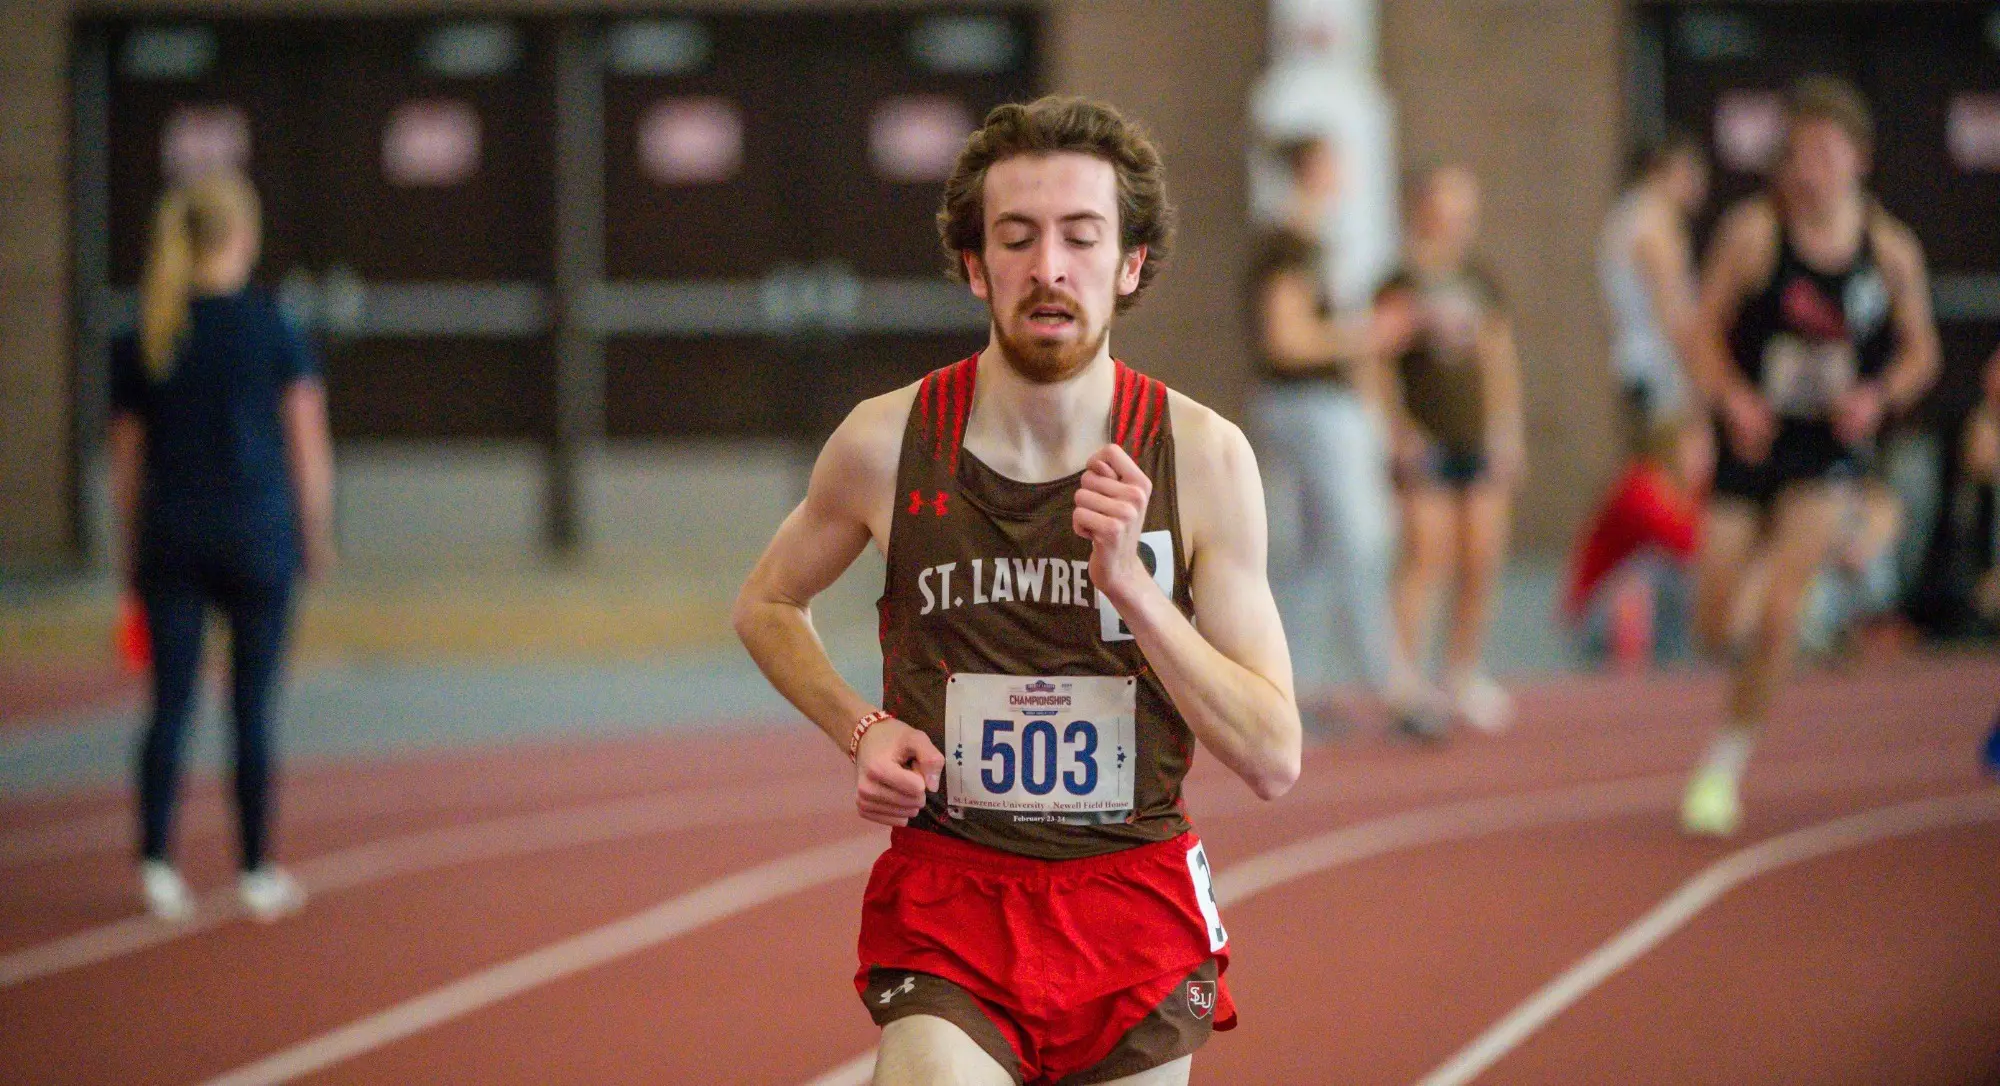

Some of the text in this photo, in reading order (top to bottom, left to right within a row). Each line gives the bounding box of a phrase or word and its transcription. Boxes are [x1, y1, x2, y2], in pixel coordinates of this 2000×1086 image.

[917, 562, 963, 615] ST.
[971, 557, 1100, 610] LAWRE
[1009, 694, 1072, 707] CHAMPIONSHIPS
[980, 719, 1099, 796] 503
[964, 797, 1002, 808] Lawrence
[1002, 800, 1045, 810] University
[1053, 801, 1082, 810] Newell
[1083, 801, 1103, 809] Field
[1105, 800, 1129, 809] House
[1013, 815, 1046, 824] February
[1189, 986, 1213, 1009] SLU
